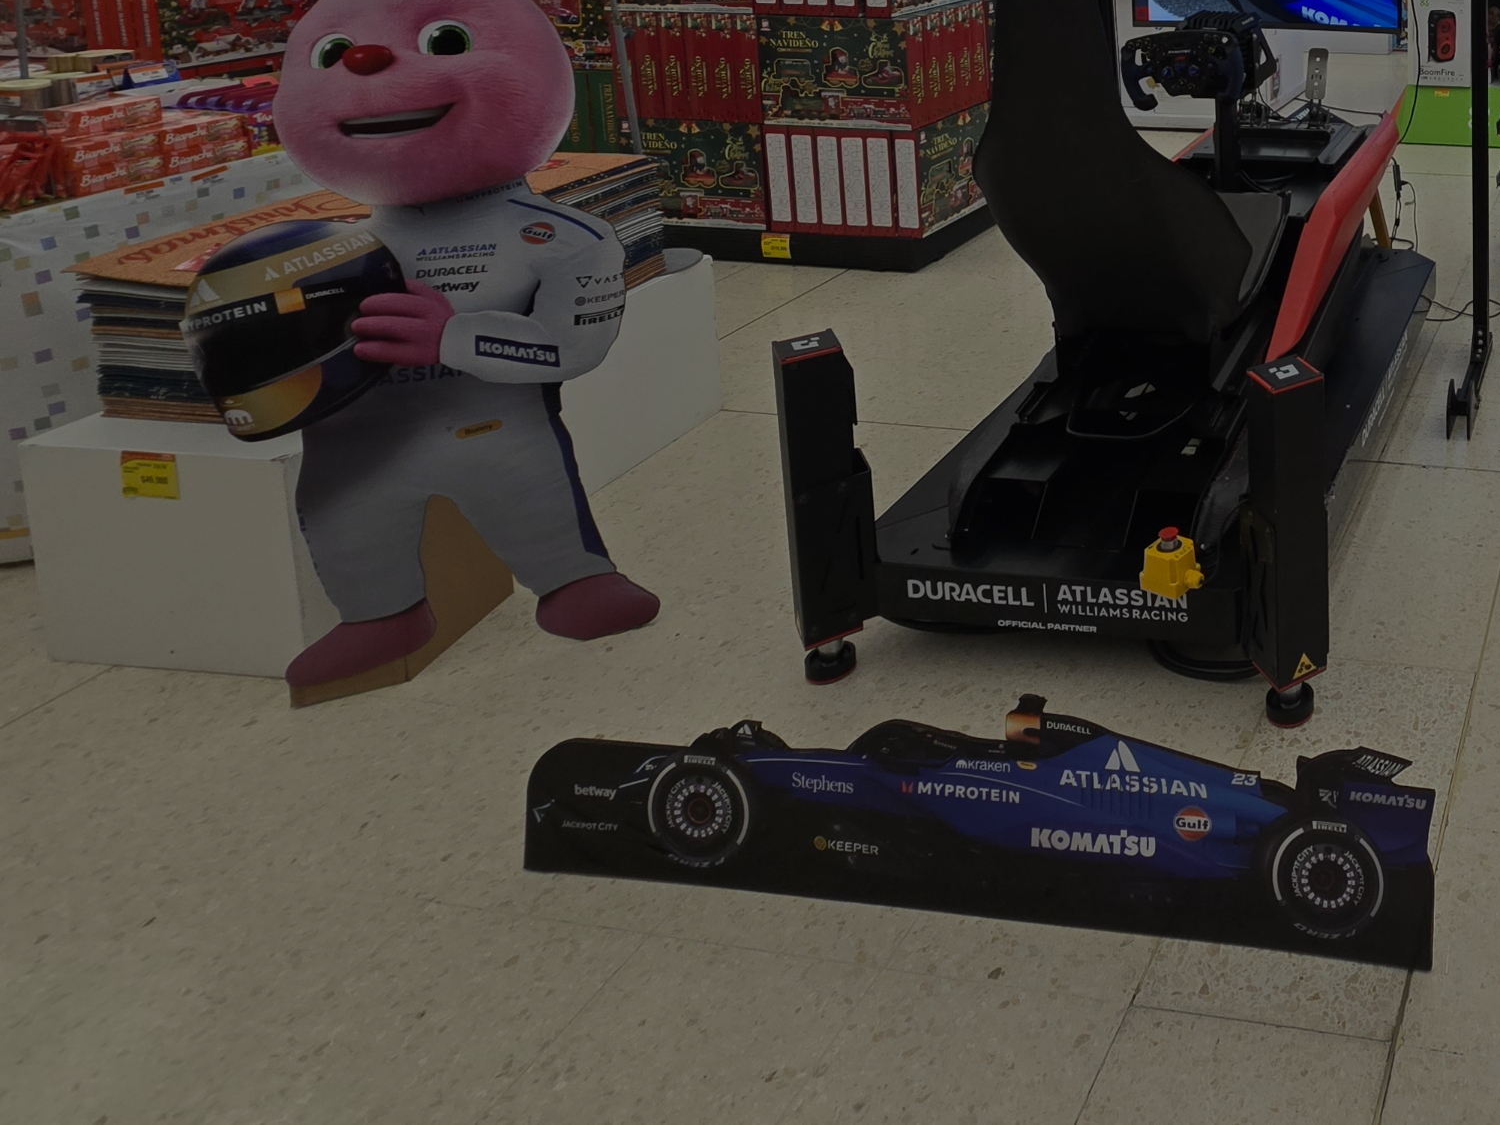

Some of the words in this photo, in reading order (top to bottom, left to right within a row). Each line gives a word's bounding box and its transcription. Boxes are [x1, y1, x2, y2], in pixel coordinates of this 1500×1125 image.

[769, 38, 819, 48] NAVIDEÑO
[780, 30, 807, 39] TREN
[1419, 68, 1456, 77] BoomFire
[79, 110, 125, 127] Bianchi
[164, 127, 208, 145] Bianchi
[73, 144, 121, 163] Bianchi
[169, 151, 214, 168] Bianchi
[80, 166, 128, 187] Bianchi
[521, 226, 555, 241] Gulf
[283, 231, 377, 275] ATLASSIAN
[428, 243, 497, 256] ATLASSIAN
[416, 264, 489, 279] DURACELL
[433, 280, 481, 294] etway
[587, 289, 625, 305] KEEPER
[479, 340, 556, 363] KOMATSU
[906, 578, 1035, 607] DURACELL
[1056, 584, 1189, 610] ATLASSIAN
[997, 618, 1045, 631] OFFICIAL
[1046, 621, 1098, 634] PARTNER
[1046, 720, 1092, 736] DURACELL
[791, 771, 855, 794] Stephens
[1058, 768, 1208, 799] ATLASSIAN
[1230, 770, 1258, 787] 23
[574, 784, 617, 800] betway
[917, 780, 1020, 804] MYPROTEIN
[1349, 790, 1427, 810] KOMATSU
[1175, 815, 1211, 832] Gulf
[827, 839, 880, 856] KEEPER
[1030, 827, 1156, 857] KOMATSU
